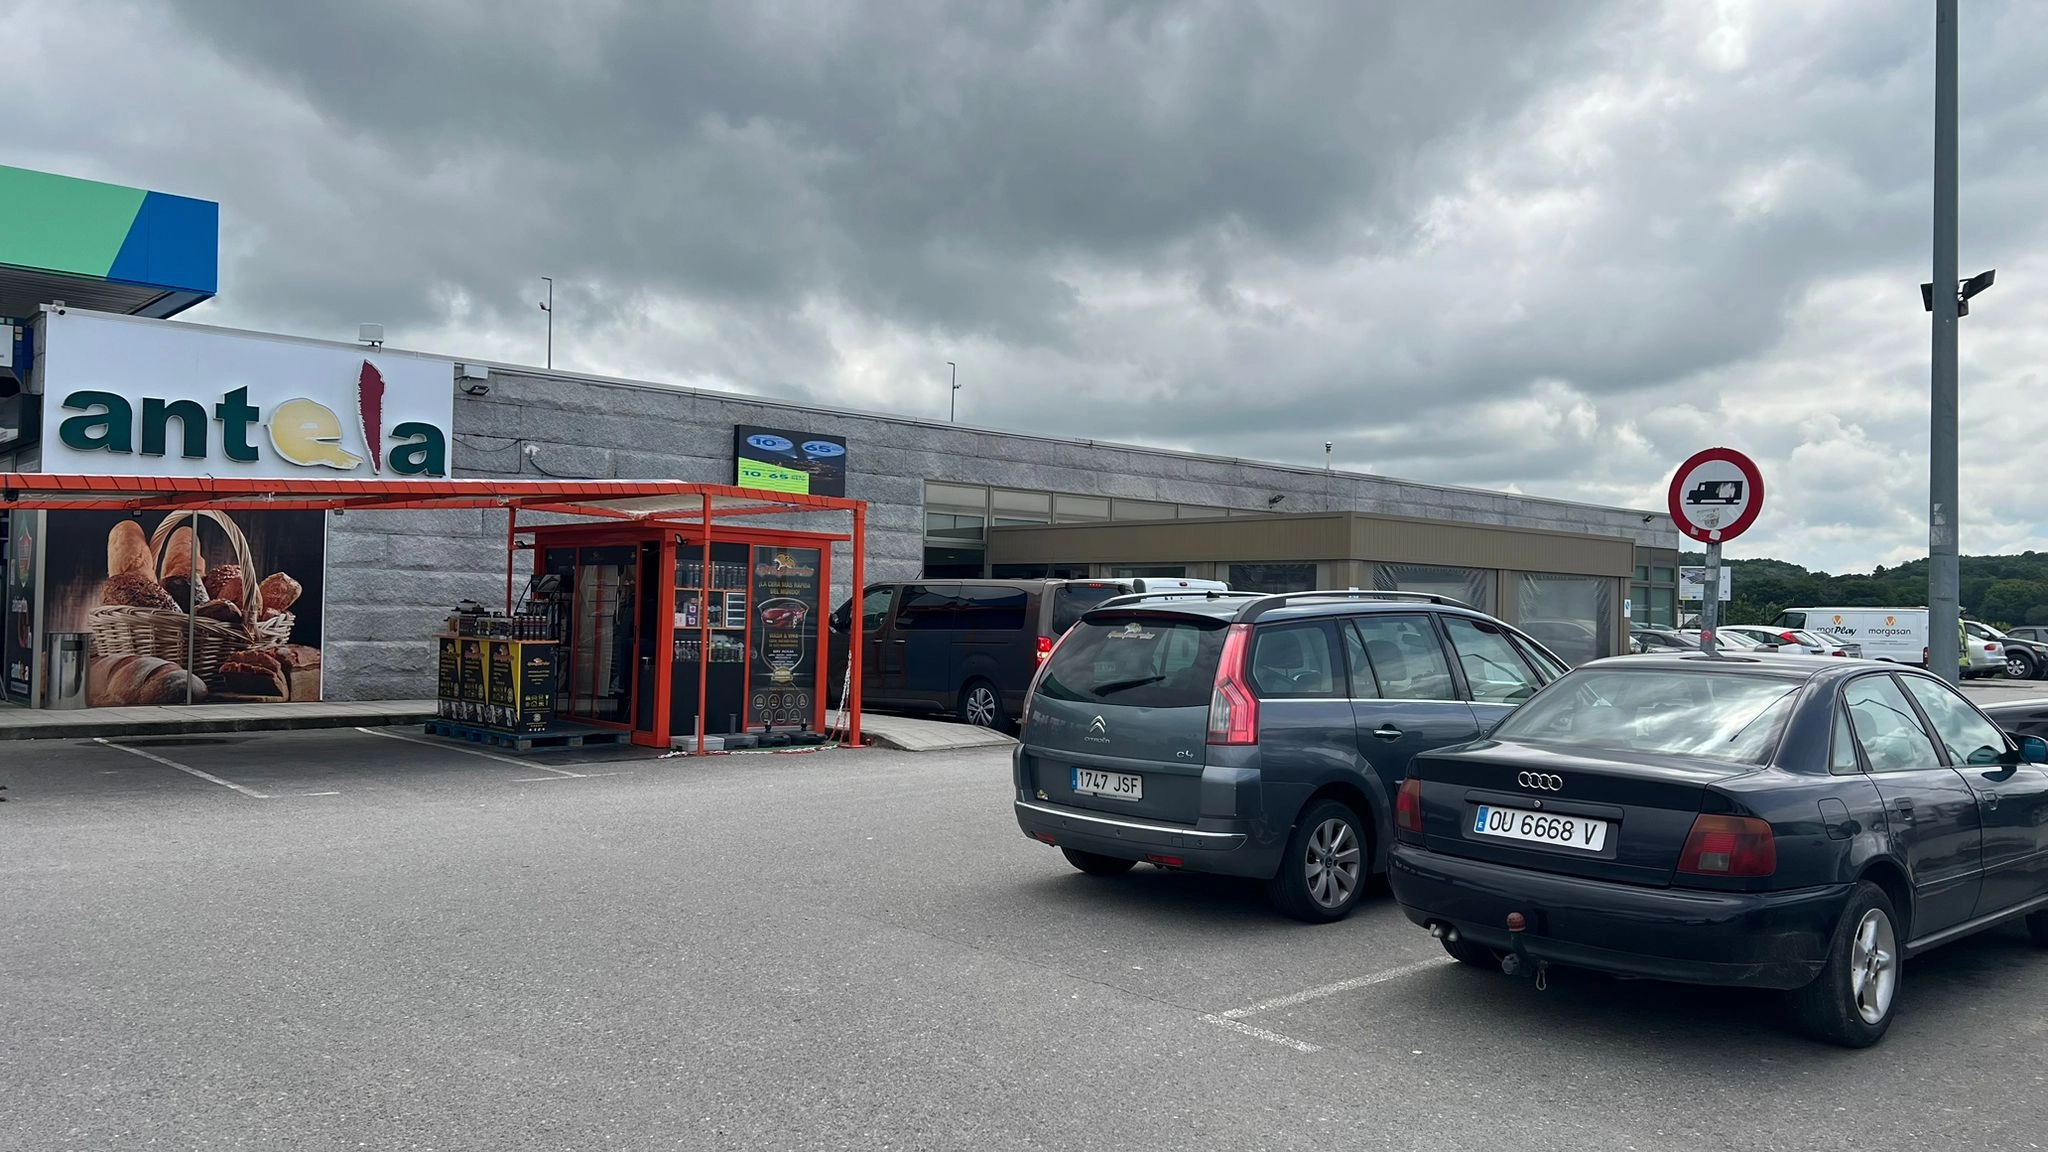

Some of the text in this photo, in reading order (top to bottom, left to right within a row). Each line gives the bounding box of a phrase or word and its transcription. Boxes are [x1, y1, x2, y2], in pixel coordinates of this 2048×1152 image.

[59, 358, 447, 477] antela
[753, 438, 777, 447] 10
[804, 444, 831, 453] 65
[1869, 627, 1911, 637] morgasan
[1176, 750, 1194, 758] C4
[1080, 771, 1138, 793] 1747 JSF
[1489, 811, 1598, 845] OU 6668 V
